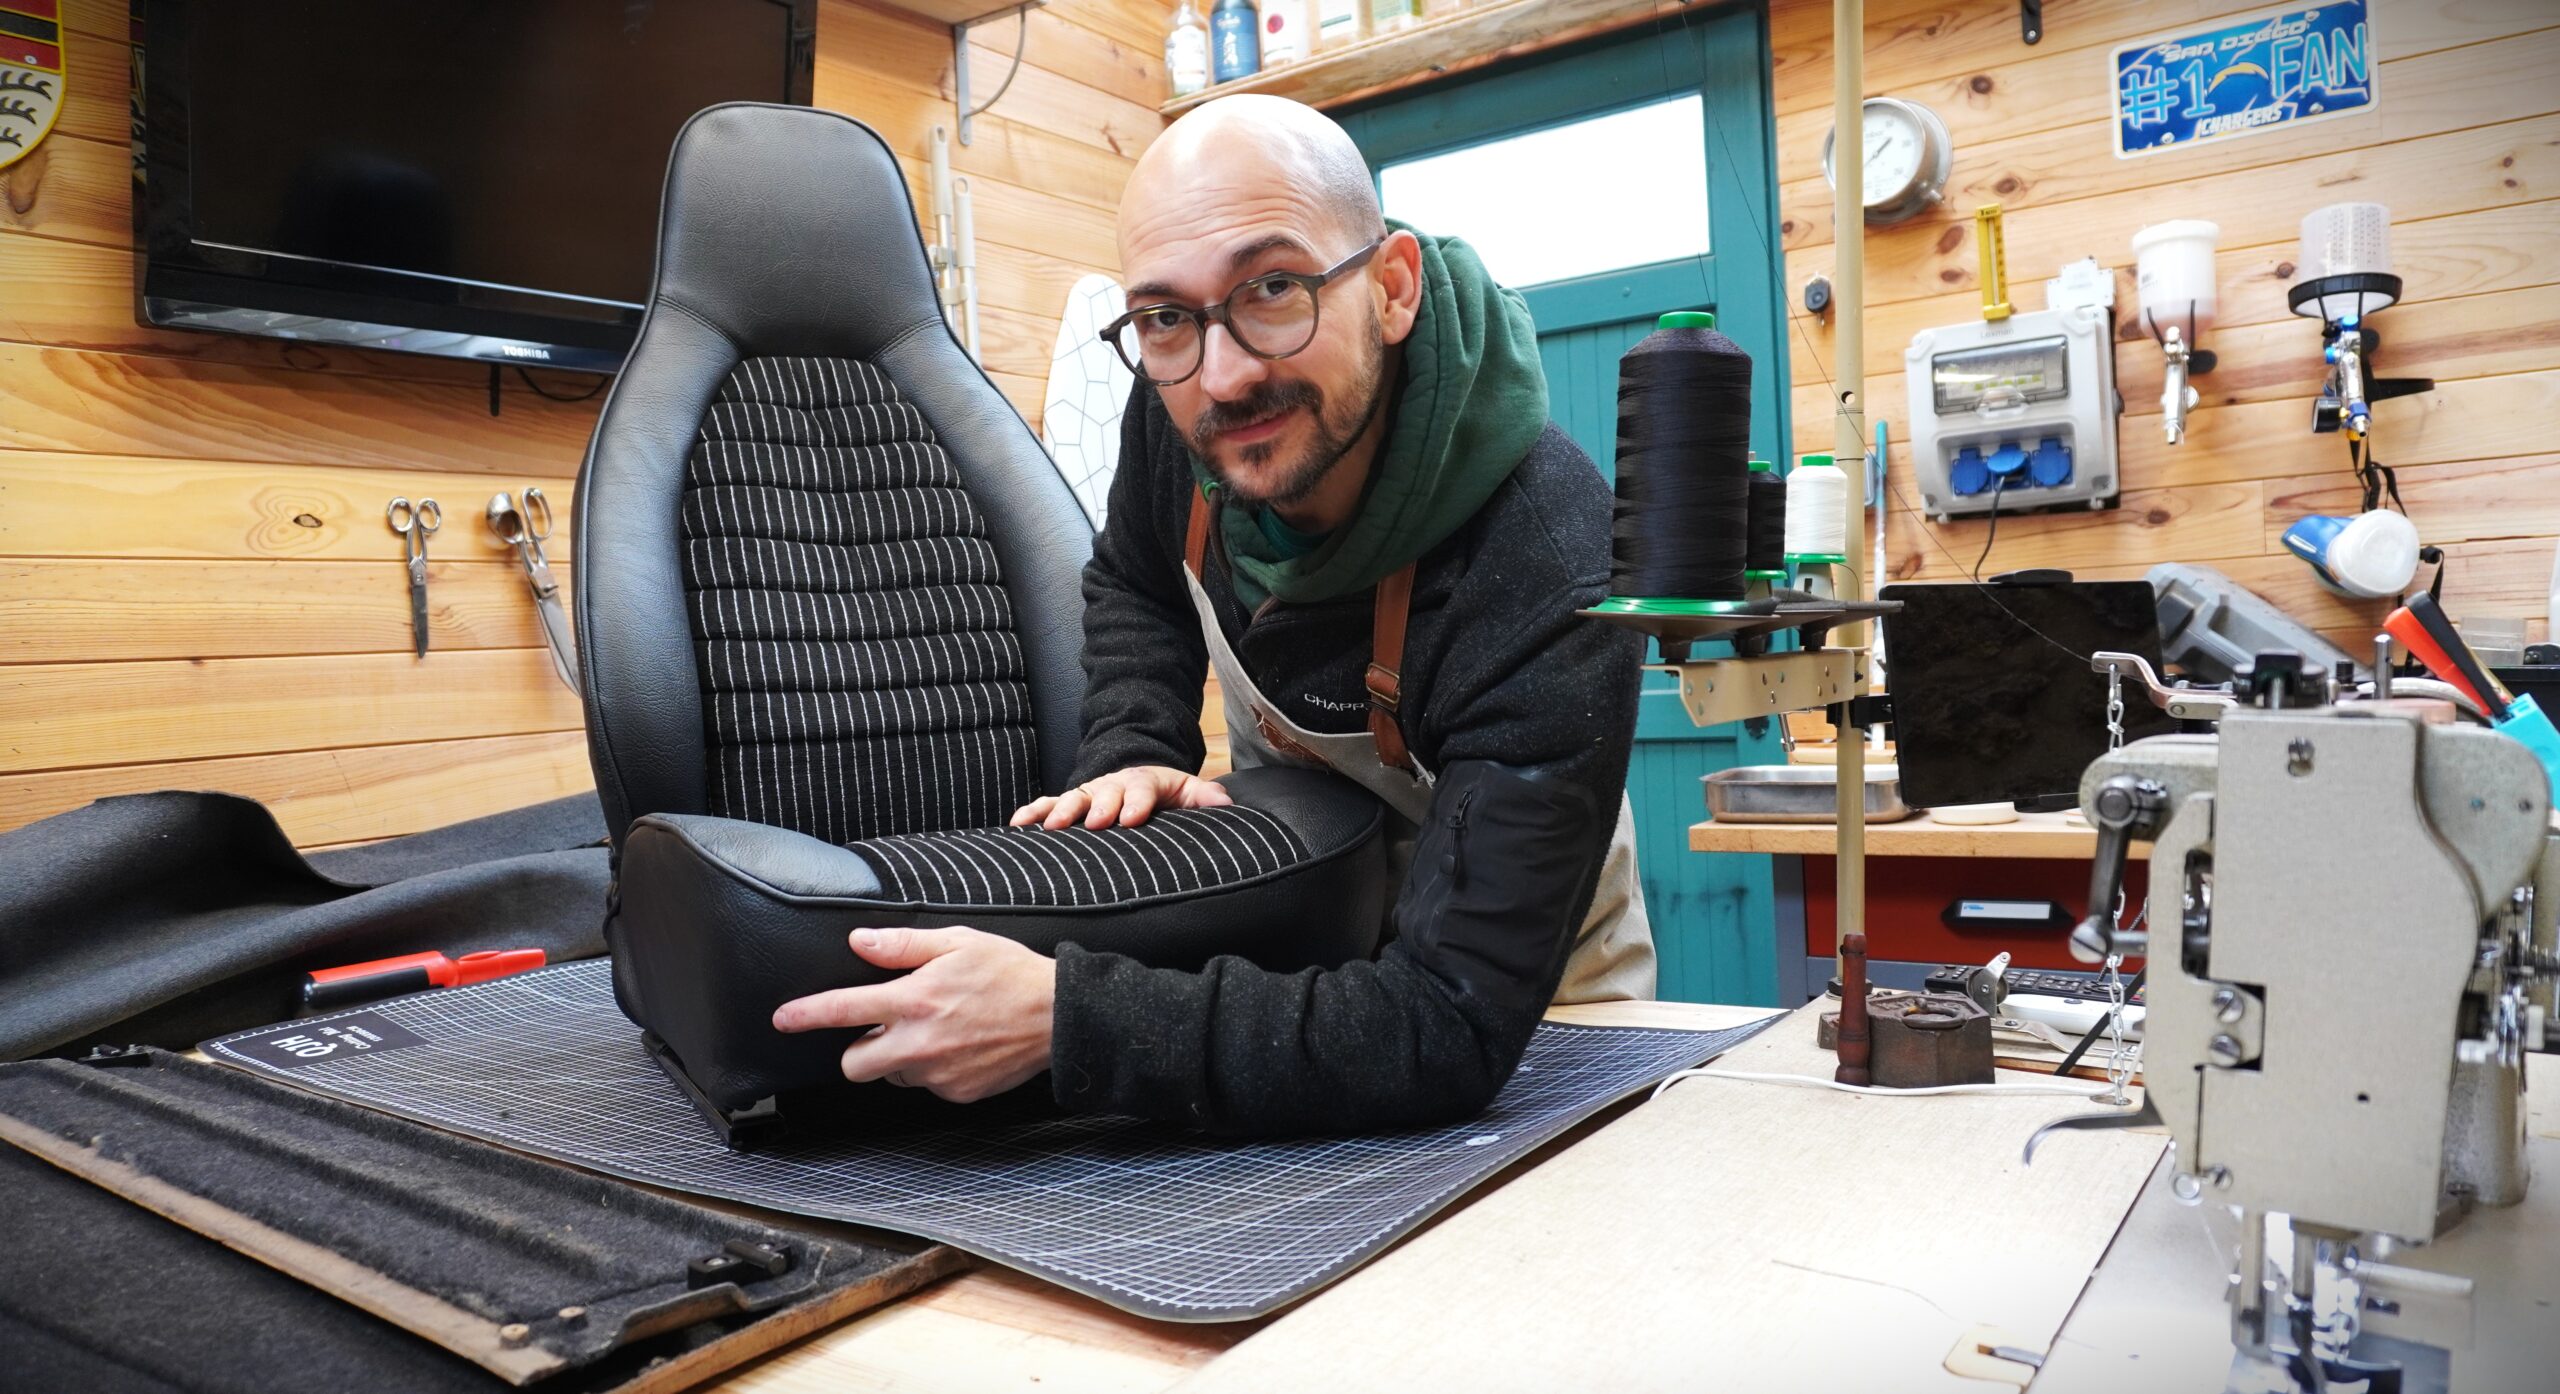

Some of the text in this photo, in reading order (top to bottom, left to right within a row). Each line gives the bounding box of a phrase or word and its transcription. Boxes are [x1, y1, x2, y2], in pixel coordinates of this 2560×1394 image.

[2163, 19, 2307, 64] SAN DIEGO
[2122, 22, 2368, 128] #1 FAN
[2199, 102, 2284, 136] CHARGERS
[502, 345, 551, 360] TOSHIBA
